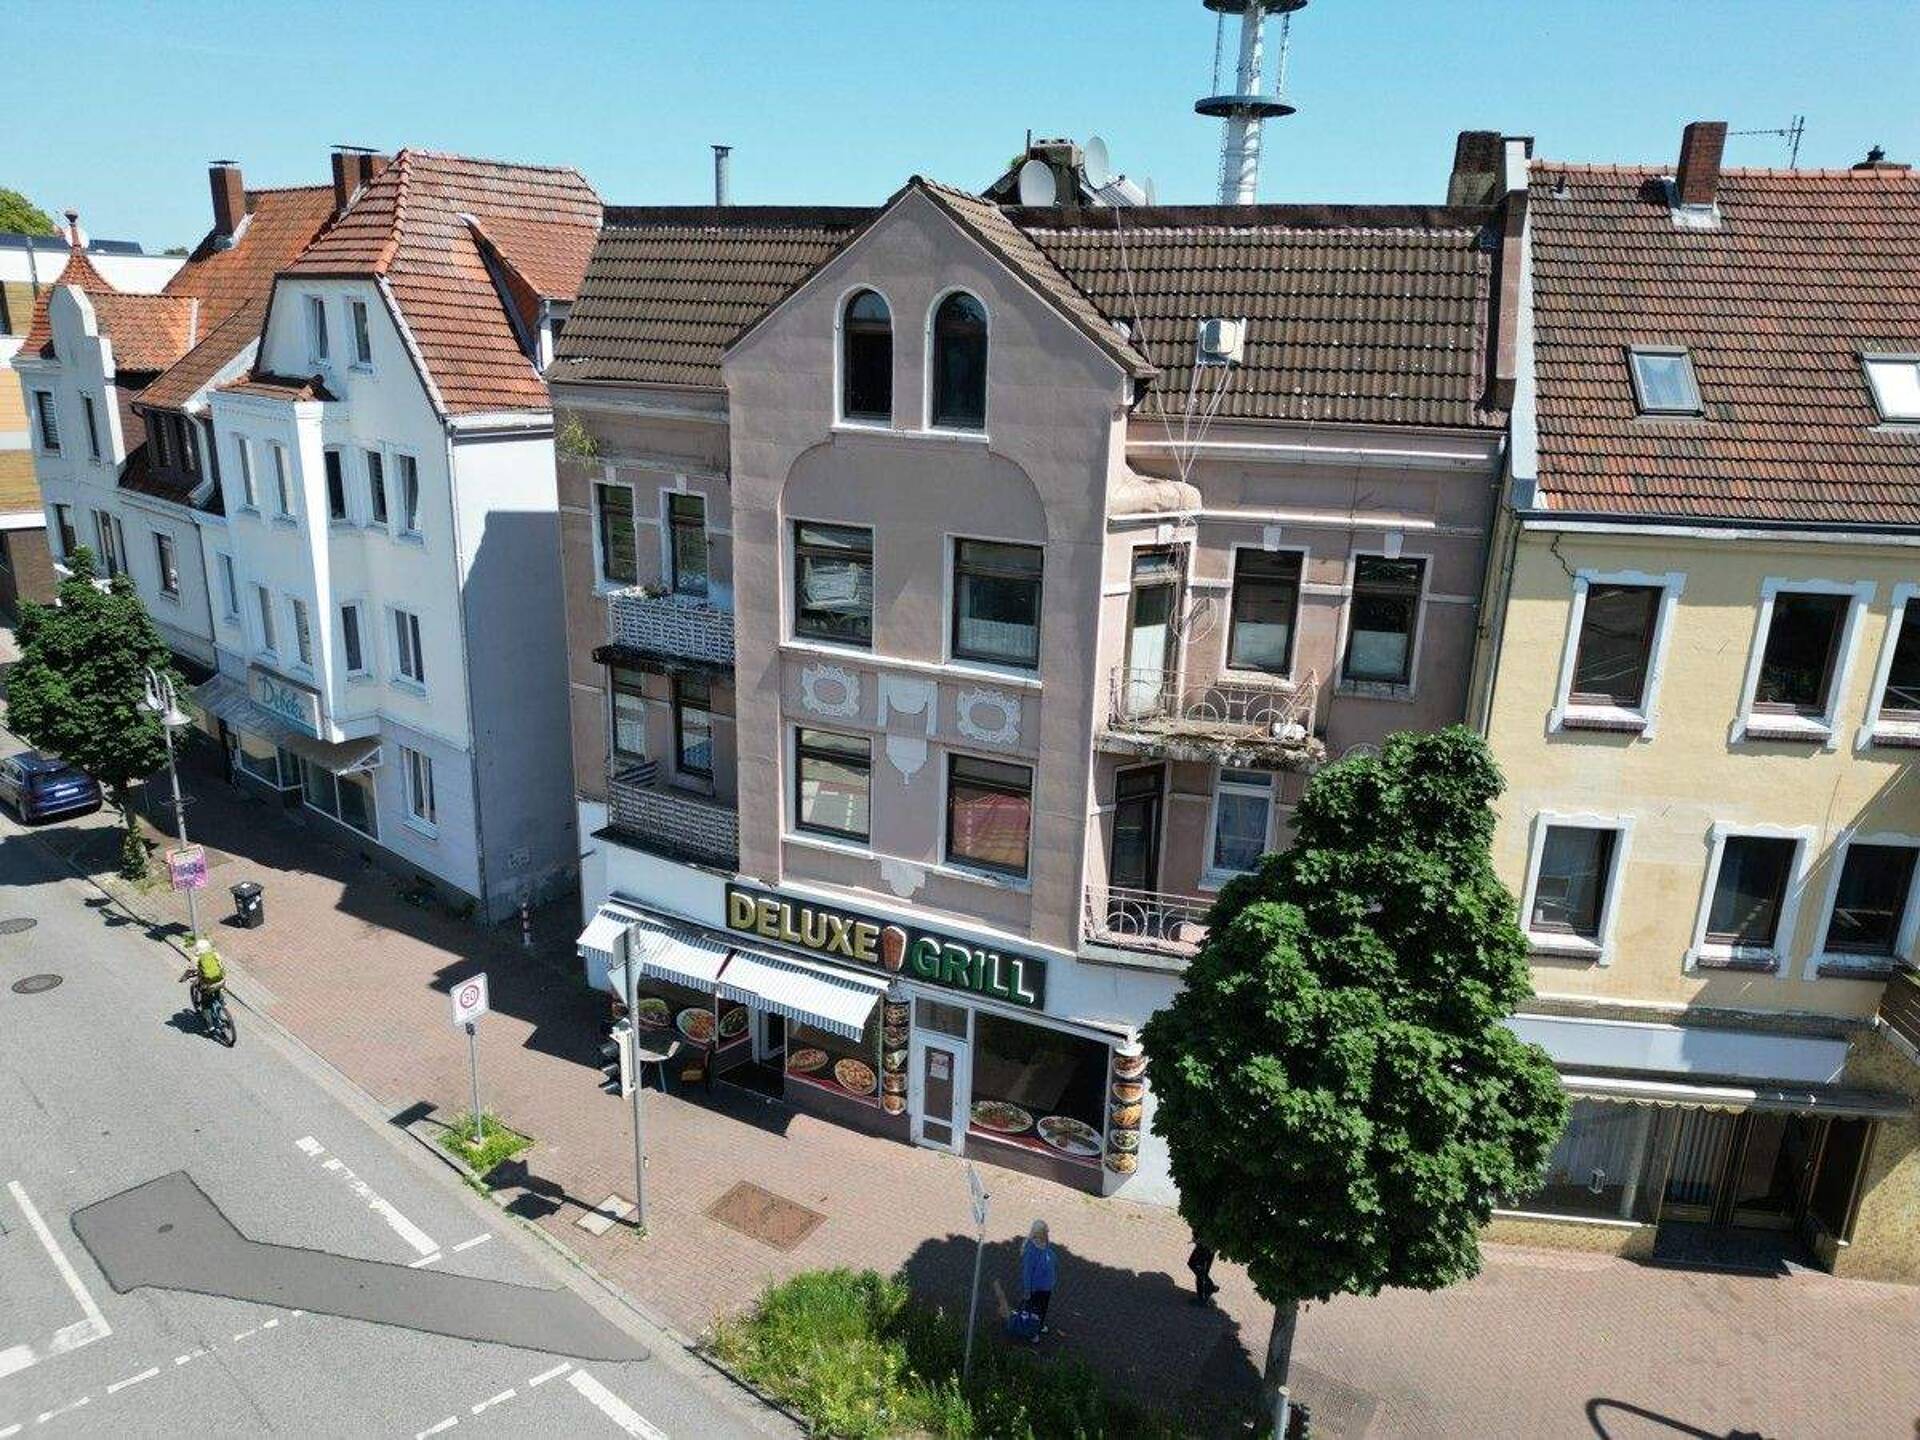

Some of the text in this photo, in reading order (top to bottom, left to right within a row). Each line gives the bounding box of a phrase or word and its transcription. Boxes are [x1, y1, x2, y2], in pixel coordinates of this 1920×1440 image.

[730, 891, 1035, 1004] DELUXE GRILL
[462, 989, 477, 1004] 30
